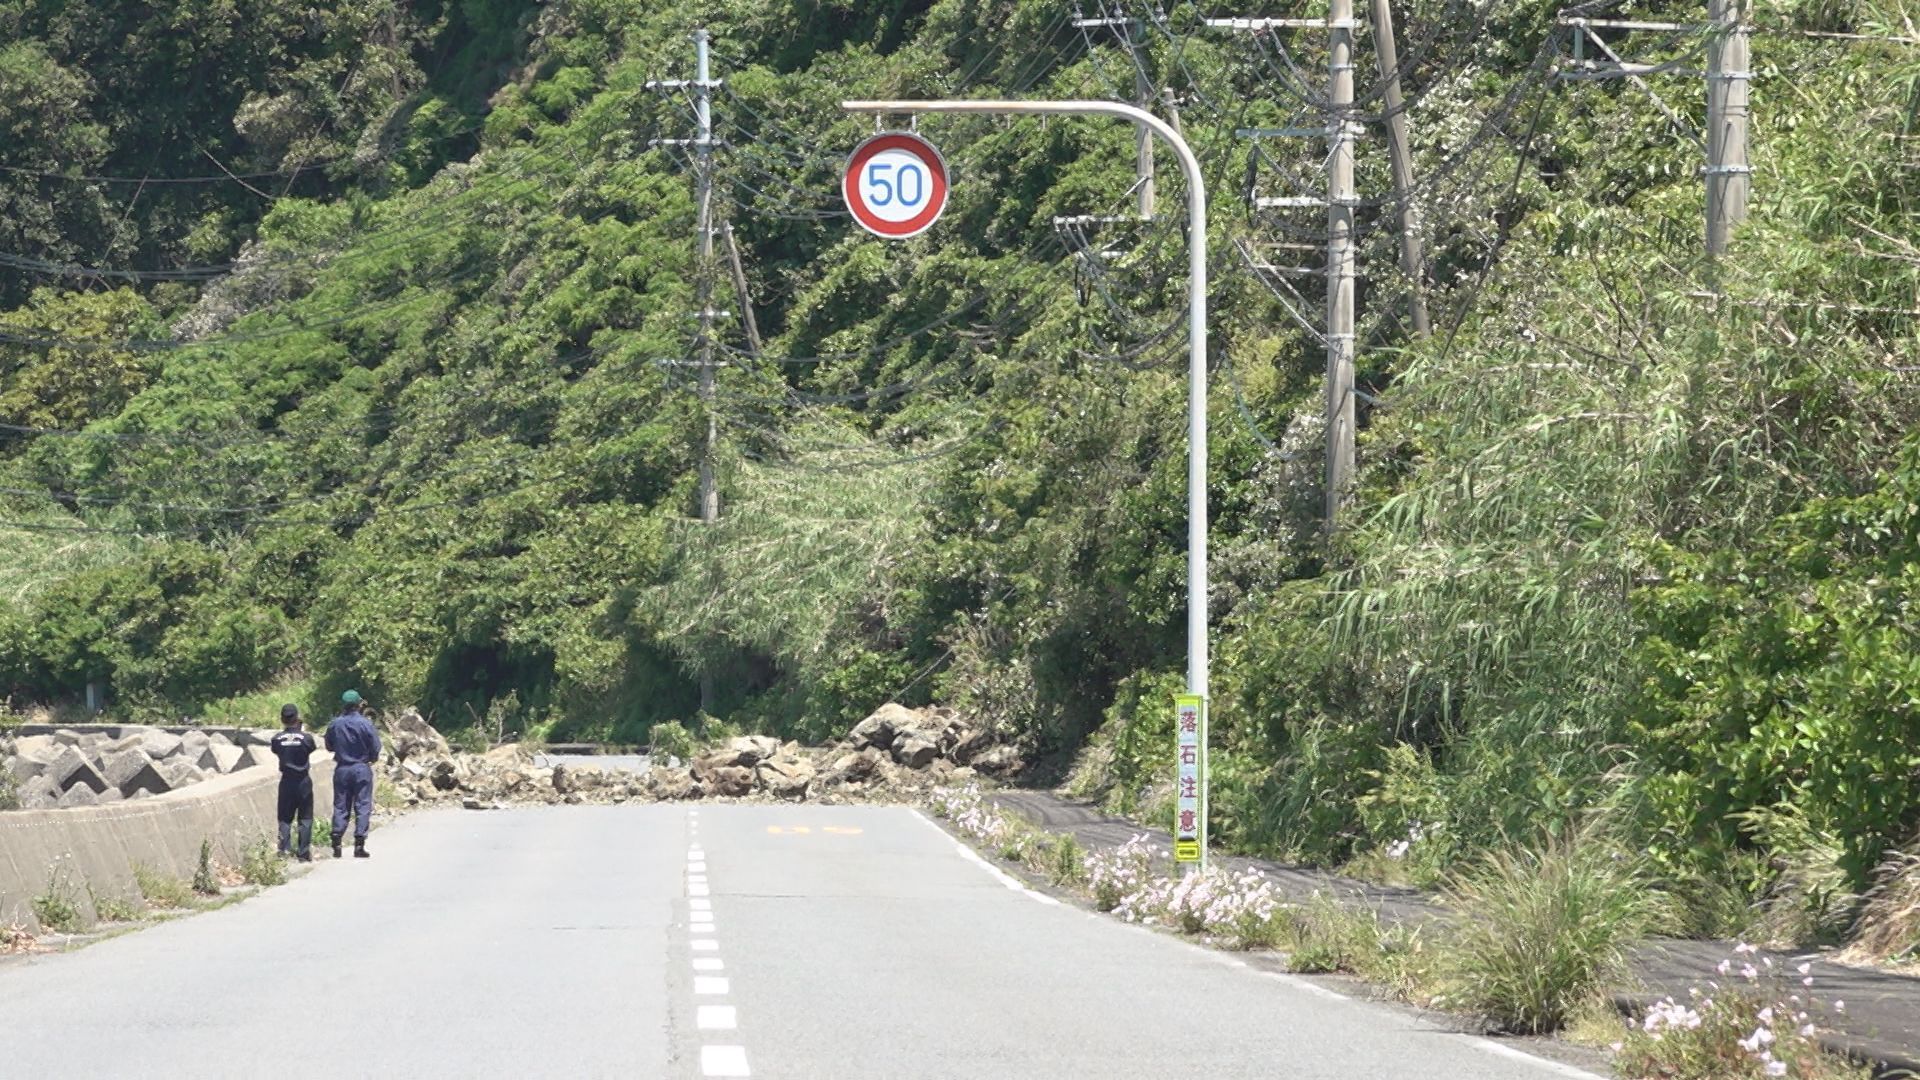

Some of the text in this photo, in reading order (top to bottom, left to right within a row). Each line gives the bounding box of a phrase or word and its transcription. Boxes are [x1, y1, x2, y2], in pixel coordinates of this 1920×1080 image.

[868, 163, 923, 207] 50
[1179, 711, 1197, 832] 落石注意
